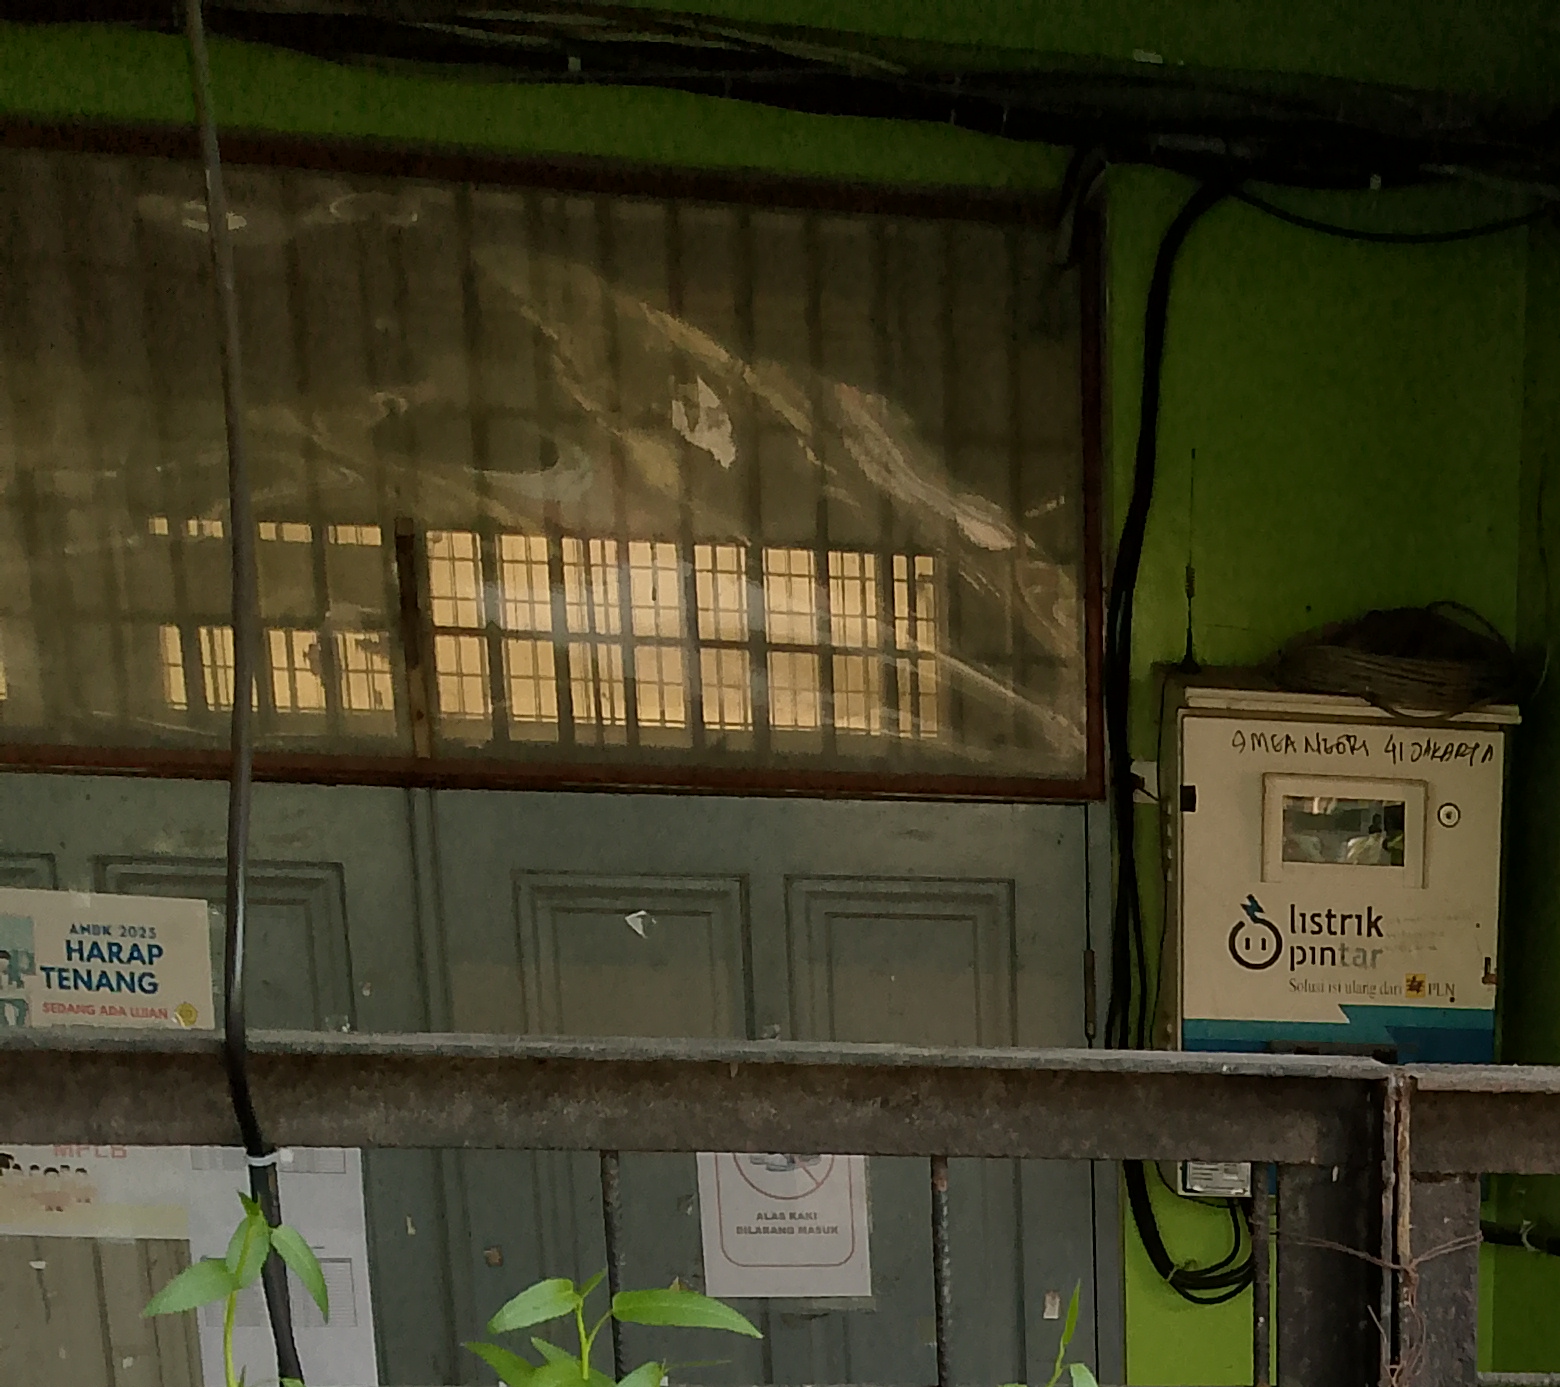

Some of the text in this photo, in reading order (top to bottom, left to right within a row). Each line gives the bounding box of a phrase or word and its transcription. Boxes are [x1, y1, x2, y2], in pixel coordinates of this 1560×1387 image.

[1384, 735, 1403, 764] 41
[1410, 738, 1494, 766] JAKARTA
[1290, 904, 1384, 937] listrik
[66, 939, 163, 966] HARAP
[1290, 943, 1384, 972] pintar
[40, 965, 159, 994] TENANG
[1289, 978, 1324, 993] Solusi
[1345, 981, 1377, 999] ulang
[1428, 982, 1456, 997] PLN
[42, 1002, 95, 1016] SEDANG
[100, 1004, 127, 1017] ADA
